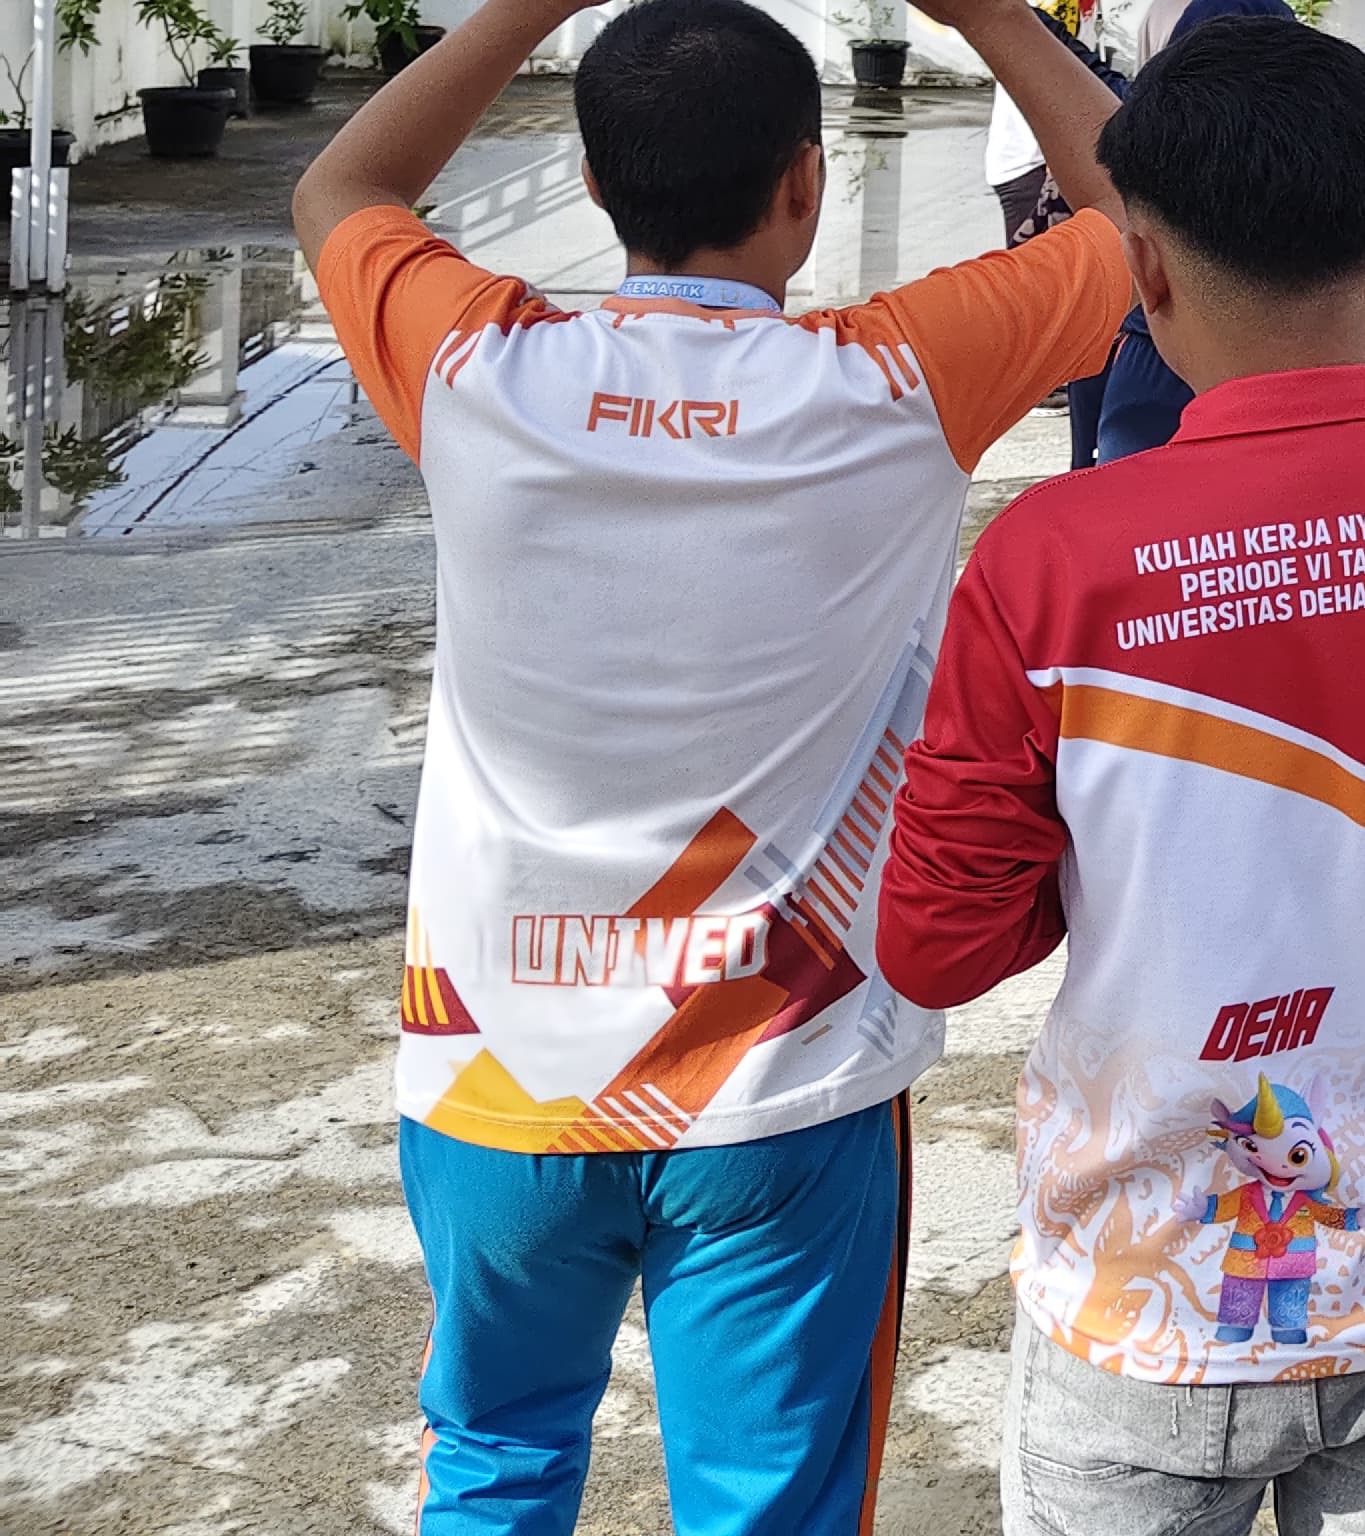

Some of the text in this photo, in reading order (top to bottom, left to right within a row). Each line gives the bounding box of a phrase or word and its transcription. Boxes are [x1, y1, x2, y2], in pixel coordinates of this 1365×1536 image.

[623, 281, 704, 298] TEMATIK
[587, 391, 739, 439] FIKRI
[1134, 530, 1237, 575] KULIAH
[1243, 518, 1332, 556] KERJA
[1180, 556, 1299, 602] PERIODE
[1304, 551, 1331, 581] VI
[1116, 592, 1293, 650] UNIVERSITAS
[512, 912, 771, 987] UNIVED
[1199, 987, 1336, 1063] DEHA
